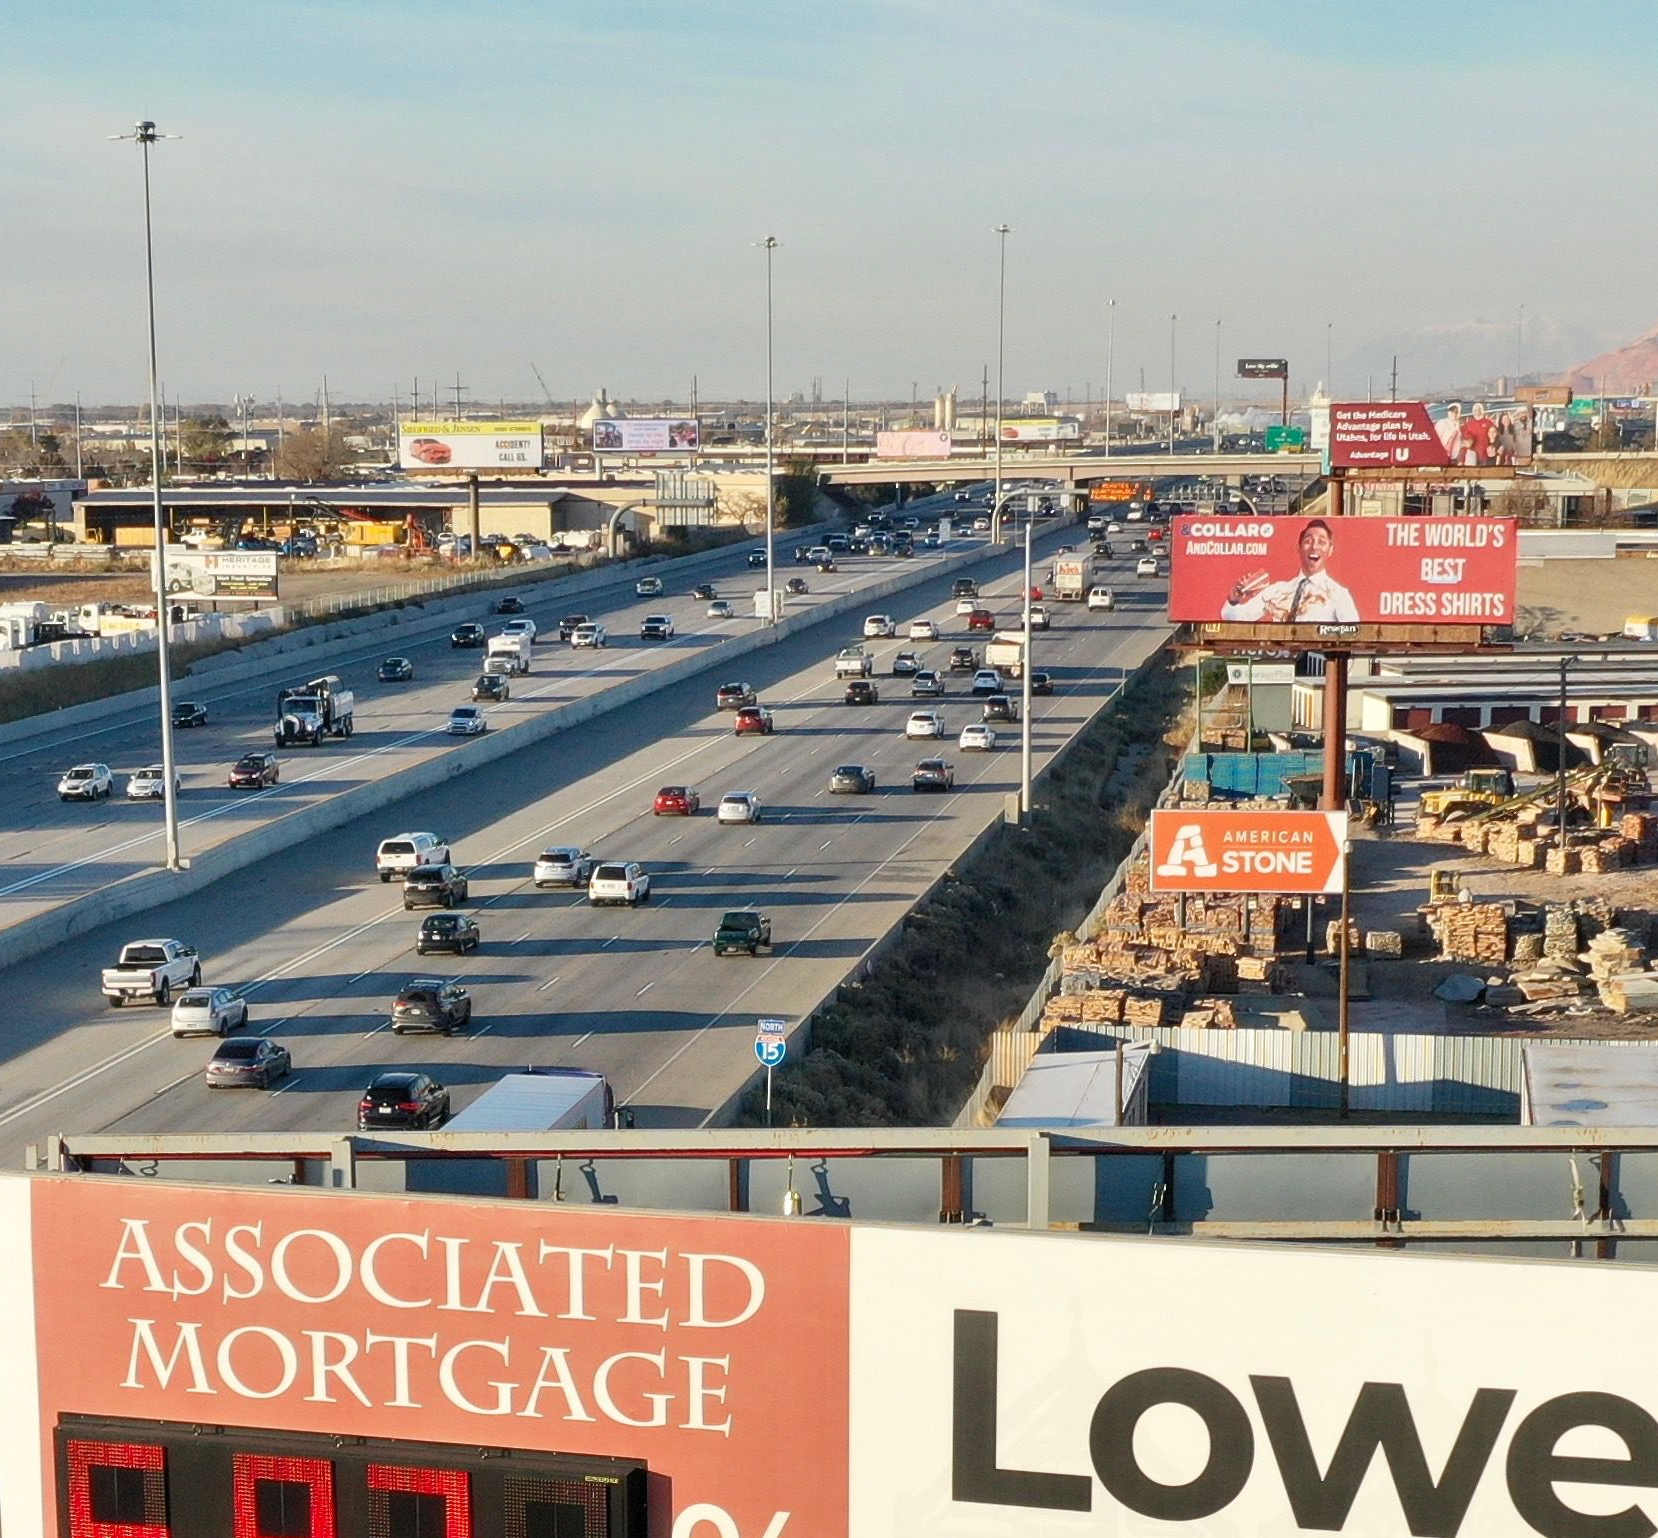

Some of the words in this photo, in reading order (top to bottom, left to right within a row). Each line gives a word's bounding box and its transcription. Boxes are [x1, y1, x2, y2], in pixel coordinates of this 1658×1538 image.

[1336, 411, 1351, 420] Get
[1353, 411, 1366, 419] the
[1368, 410, 1407, 419] Medicare
[1336, 422, 1380, 431] Advantage
[1382, 422, 1400, 431] plan
[1402, 422, 1413, 431] by
[1370, 433, 1382, 441] for
[1383, 433, 1396, 441] life
[1350, 451, 1390, 460] Advantage
[1386, 523, 1420, 547] THE
[1424, 523, 1505, 548] WORLD'S
[1420, 558, 1466, 582] BEST
[1380, 592, 1437, 616] DRESS
[1440, 592, 1505, 617] SHIRTS
[1223, 830, 1314, 844] AMERICAN
[1222, 851, 1313, 874] STONE
[760, 1022, 783, 1032] NORTH
[762, 1042, 779, 1060] 15
[99, 1218, 766, 1332] ASSOCIATED
[119, 1318, 734, 1438] MORTGAGE
